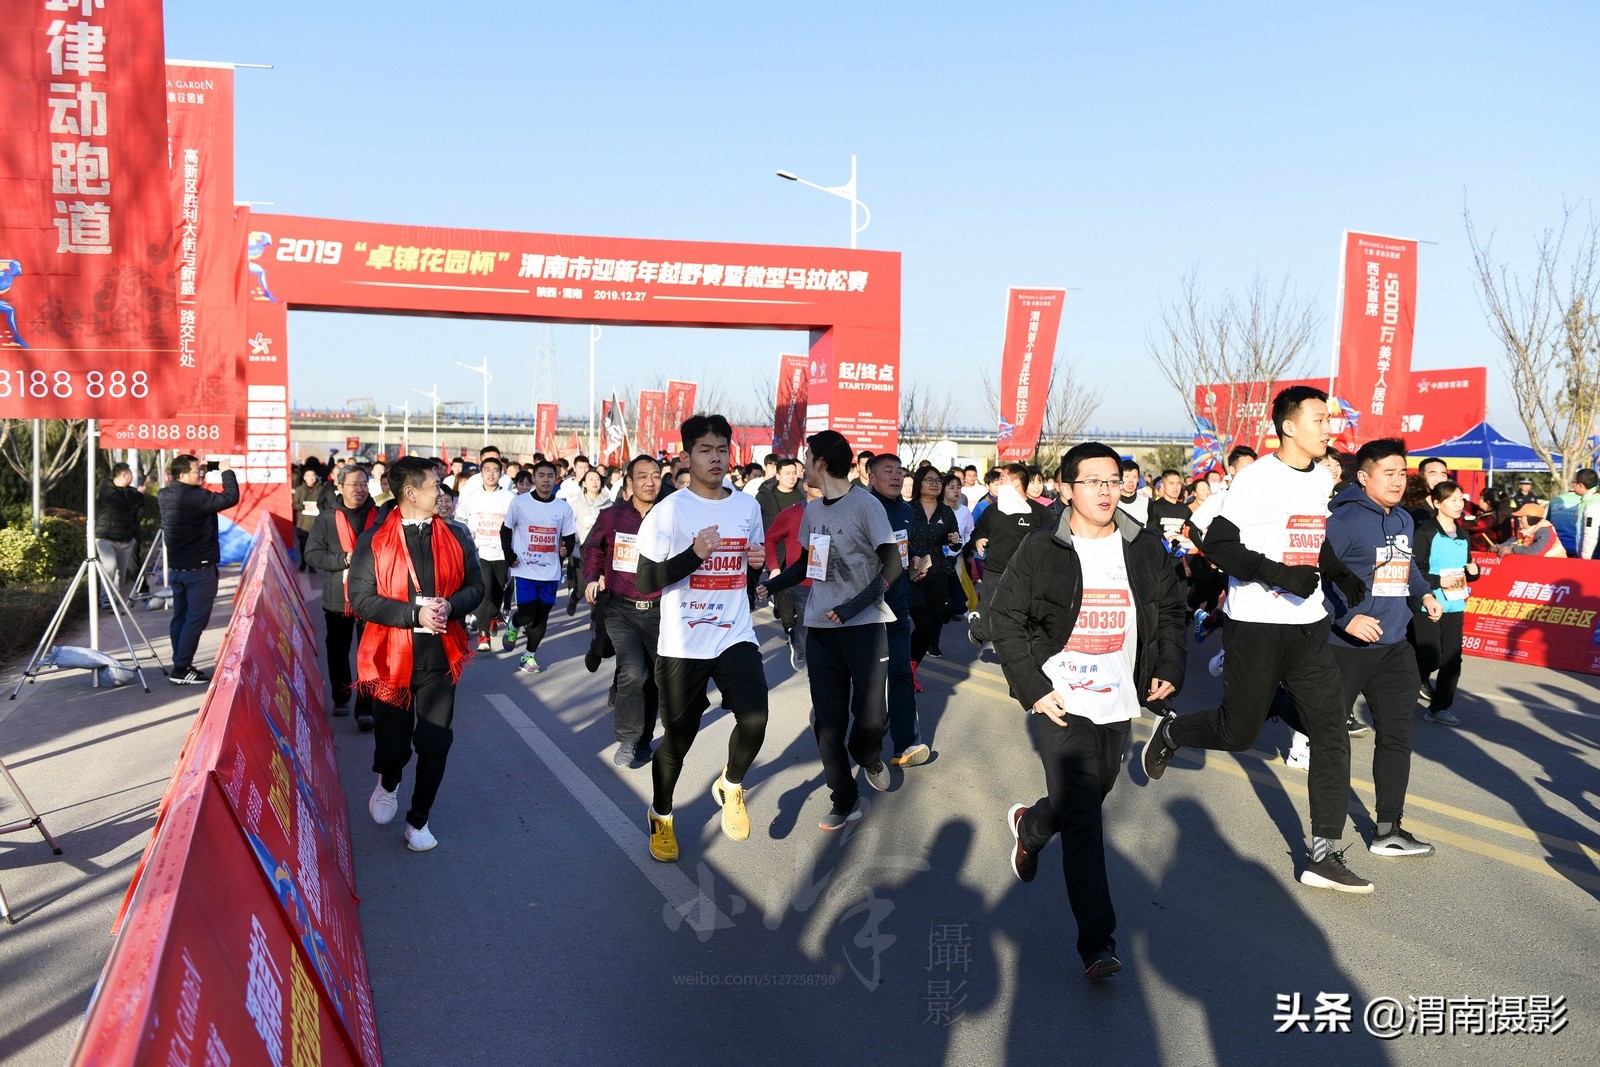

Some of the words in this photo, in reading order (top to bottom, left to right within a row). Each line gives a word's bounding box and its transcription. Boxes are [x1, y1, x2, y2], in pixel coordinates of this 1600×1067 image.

[176, 80, 214, 90] GARDEN
[179, 149, 199, 368] 高新区胜利大街与新盛一路交汇处
[276, 238, 342, 265] 2019
[354, 241, 510, 276] “卓锦花园杯”
[518, 252, 868, 293] 渭南市迎新年越野赛暨微型马拉松赛
[594, 290, 647, 302] 2019.12.27
[1365, 261, 1380, 317] 西北首席
[838, 362, 895, 382] 起/终点
[1015, 310, 1041, 427] 渭南首个海派花园住区
[86, 371, 149, 399] 888
[838, 382, 894, 392] START/FINISH
[138, 424, 180, 440] 8188
[186, 424, 220, 440] 888
[1508, 581, 1571, 602] 渭南首个
[1075, 610, 1127, 630] 50330
[1464, 596, 1597, 628] 新加坡海派花园住区
